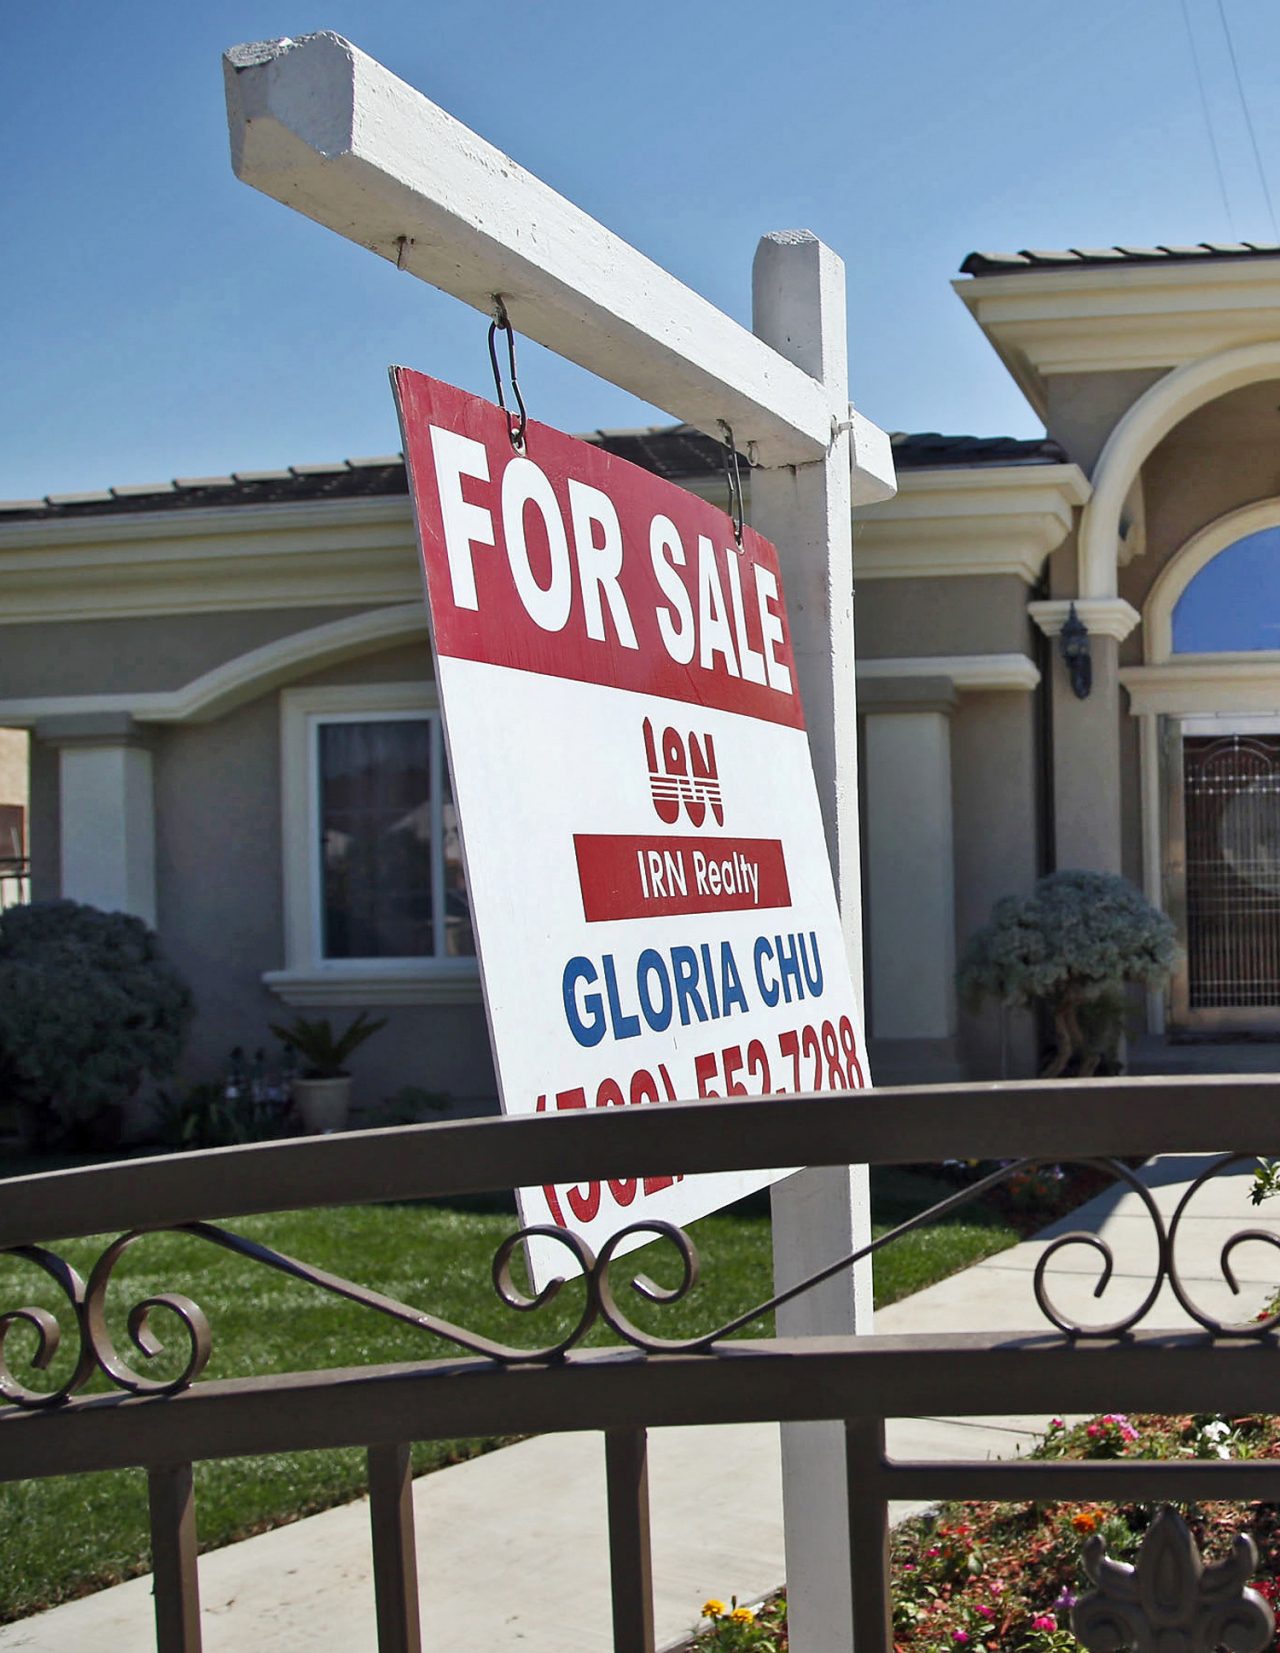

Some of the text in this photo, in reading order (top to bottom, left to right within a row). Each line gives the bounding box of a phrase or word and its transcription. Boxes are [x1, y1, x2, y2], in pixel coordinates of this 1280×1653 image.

[429, 425, 794, 695] FOR SALE
[637, 850, 760, 904] IRN Realty
[562, 931, 824, 1048] GLORIA CHU
